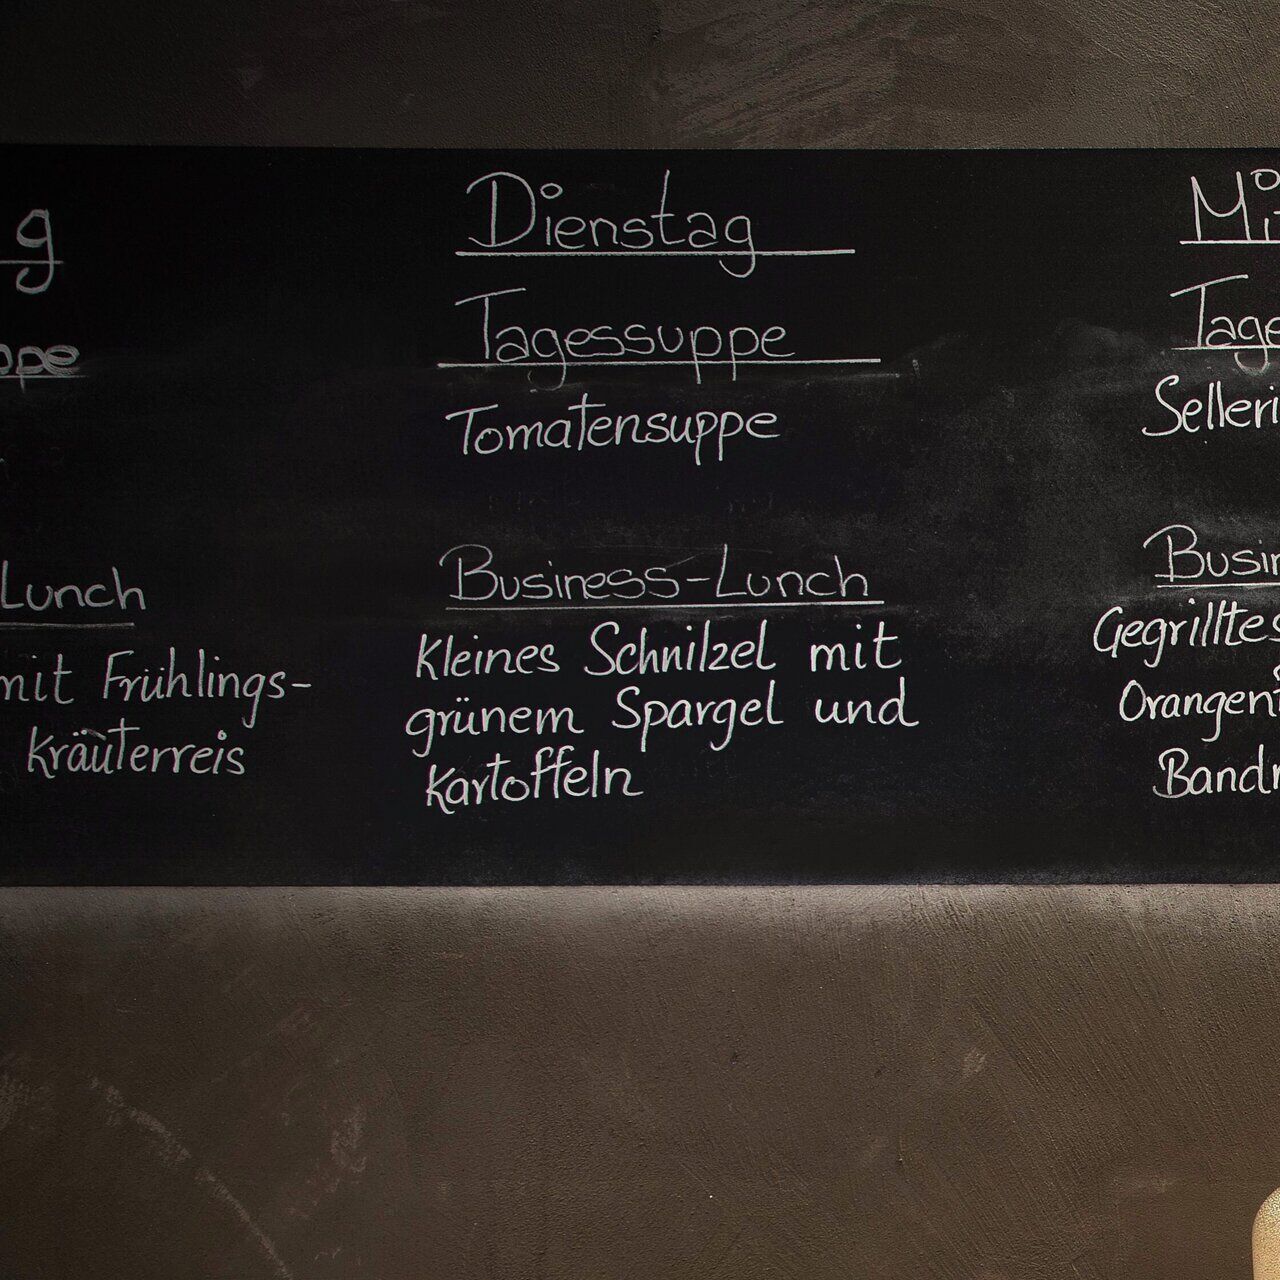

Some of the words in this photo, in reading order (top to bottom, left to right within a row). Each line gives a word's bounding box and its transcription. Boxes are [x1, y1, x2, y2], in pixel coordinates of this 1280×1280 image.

[465, 168, 757, 277] Dienstag
[455, 287, 796, 393] Tagessuppe
[445, 392, 781, 465] Tomatensuppe
[439, 543, 870, 601] Business-Lunch
[103, 646, 313, 729] Frühlings-
[415, 632, 561, 681] Kleines
[809, 621, 902, 671] mit
[26, 717, 246, 779] Kräuterreis
[405, 697, 584, 758] grünem
[612, 679, 784, 752] Spargel
[814, 676, 920, 727] und
